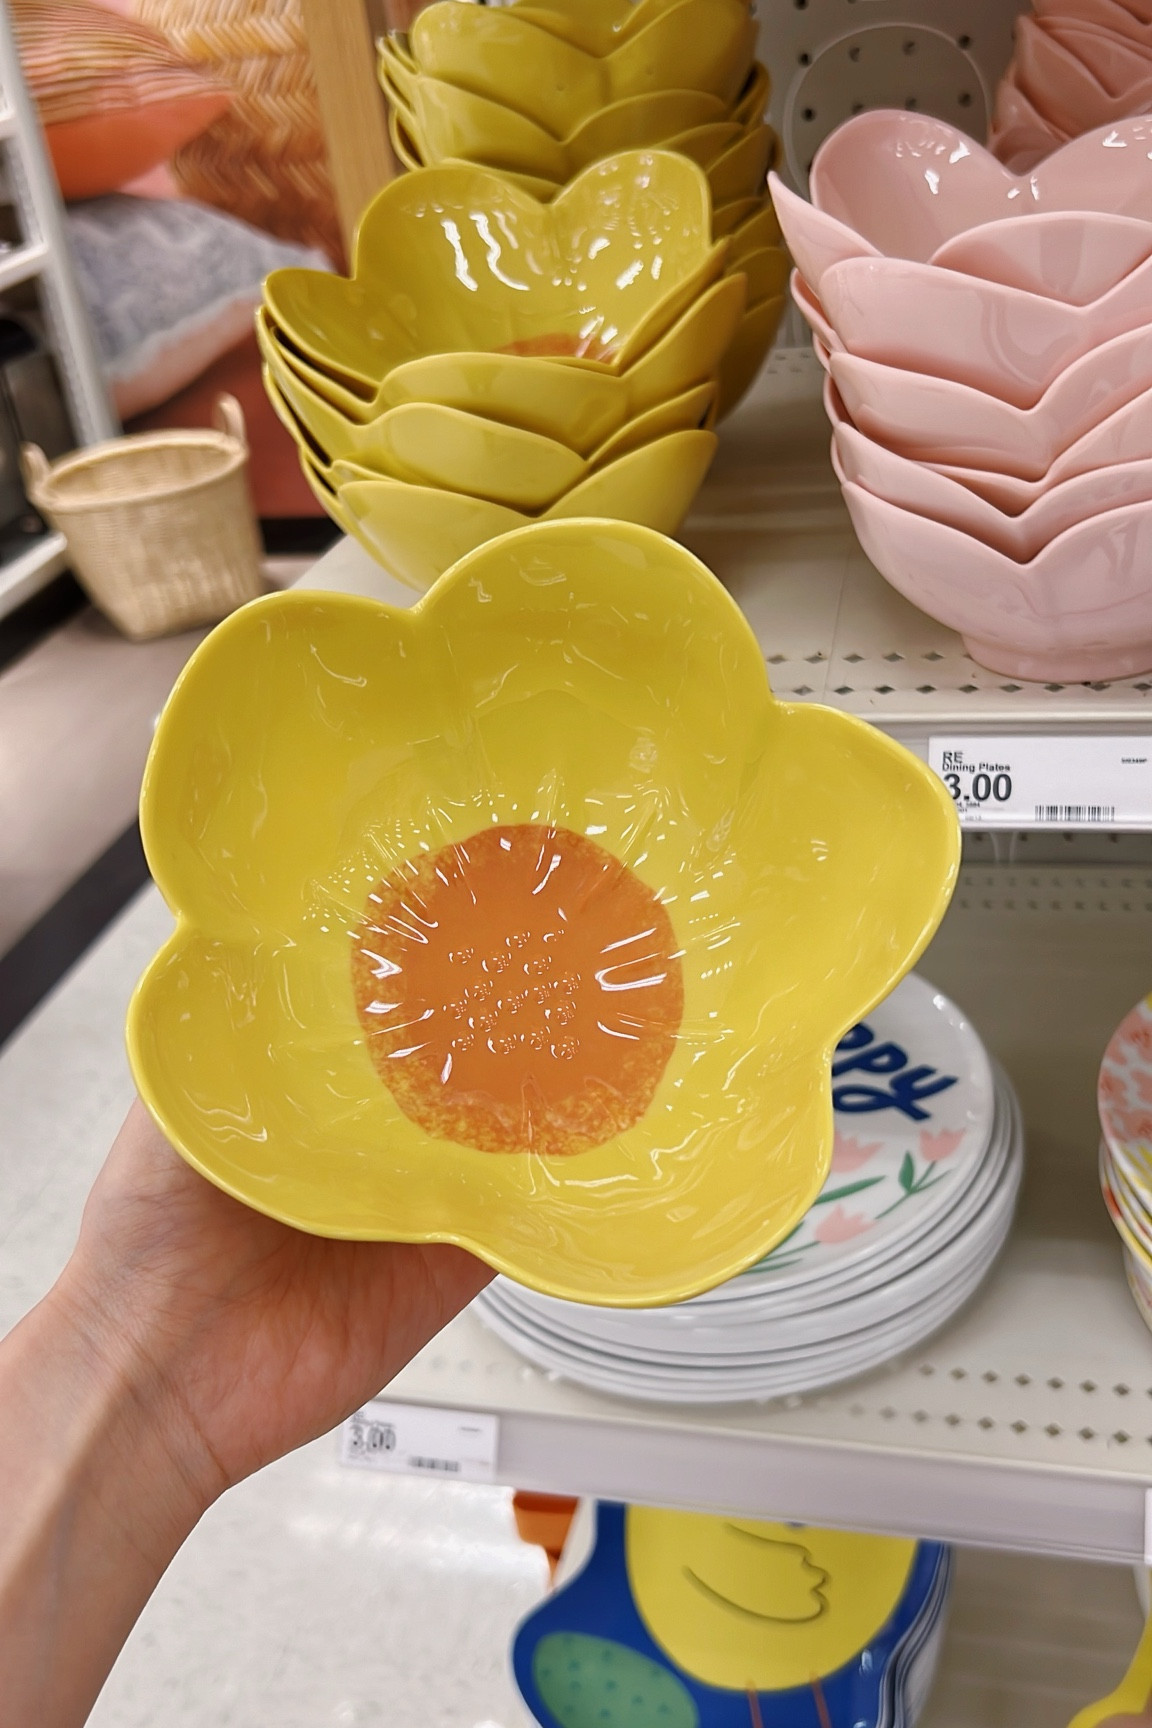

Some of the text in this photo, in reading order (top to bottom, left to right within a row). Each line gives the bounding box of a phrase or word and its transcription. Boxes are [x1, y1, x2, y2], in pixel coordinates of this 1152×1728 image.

[942, 762, 1011, 773] Dining Plates
[943, 773, 1012, 802] 3.00
[832, 1022, 958, 1120] ppy
